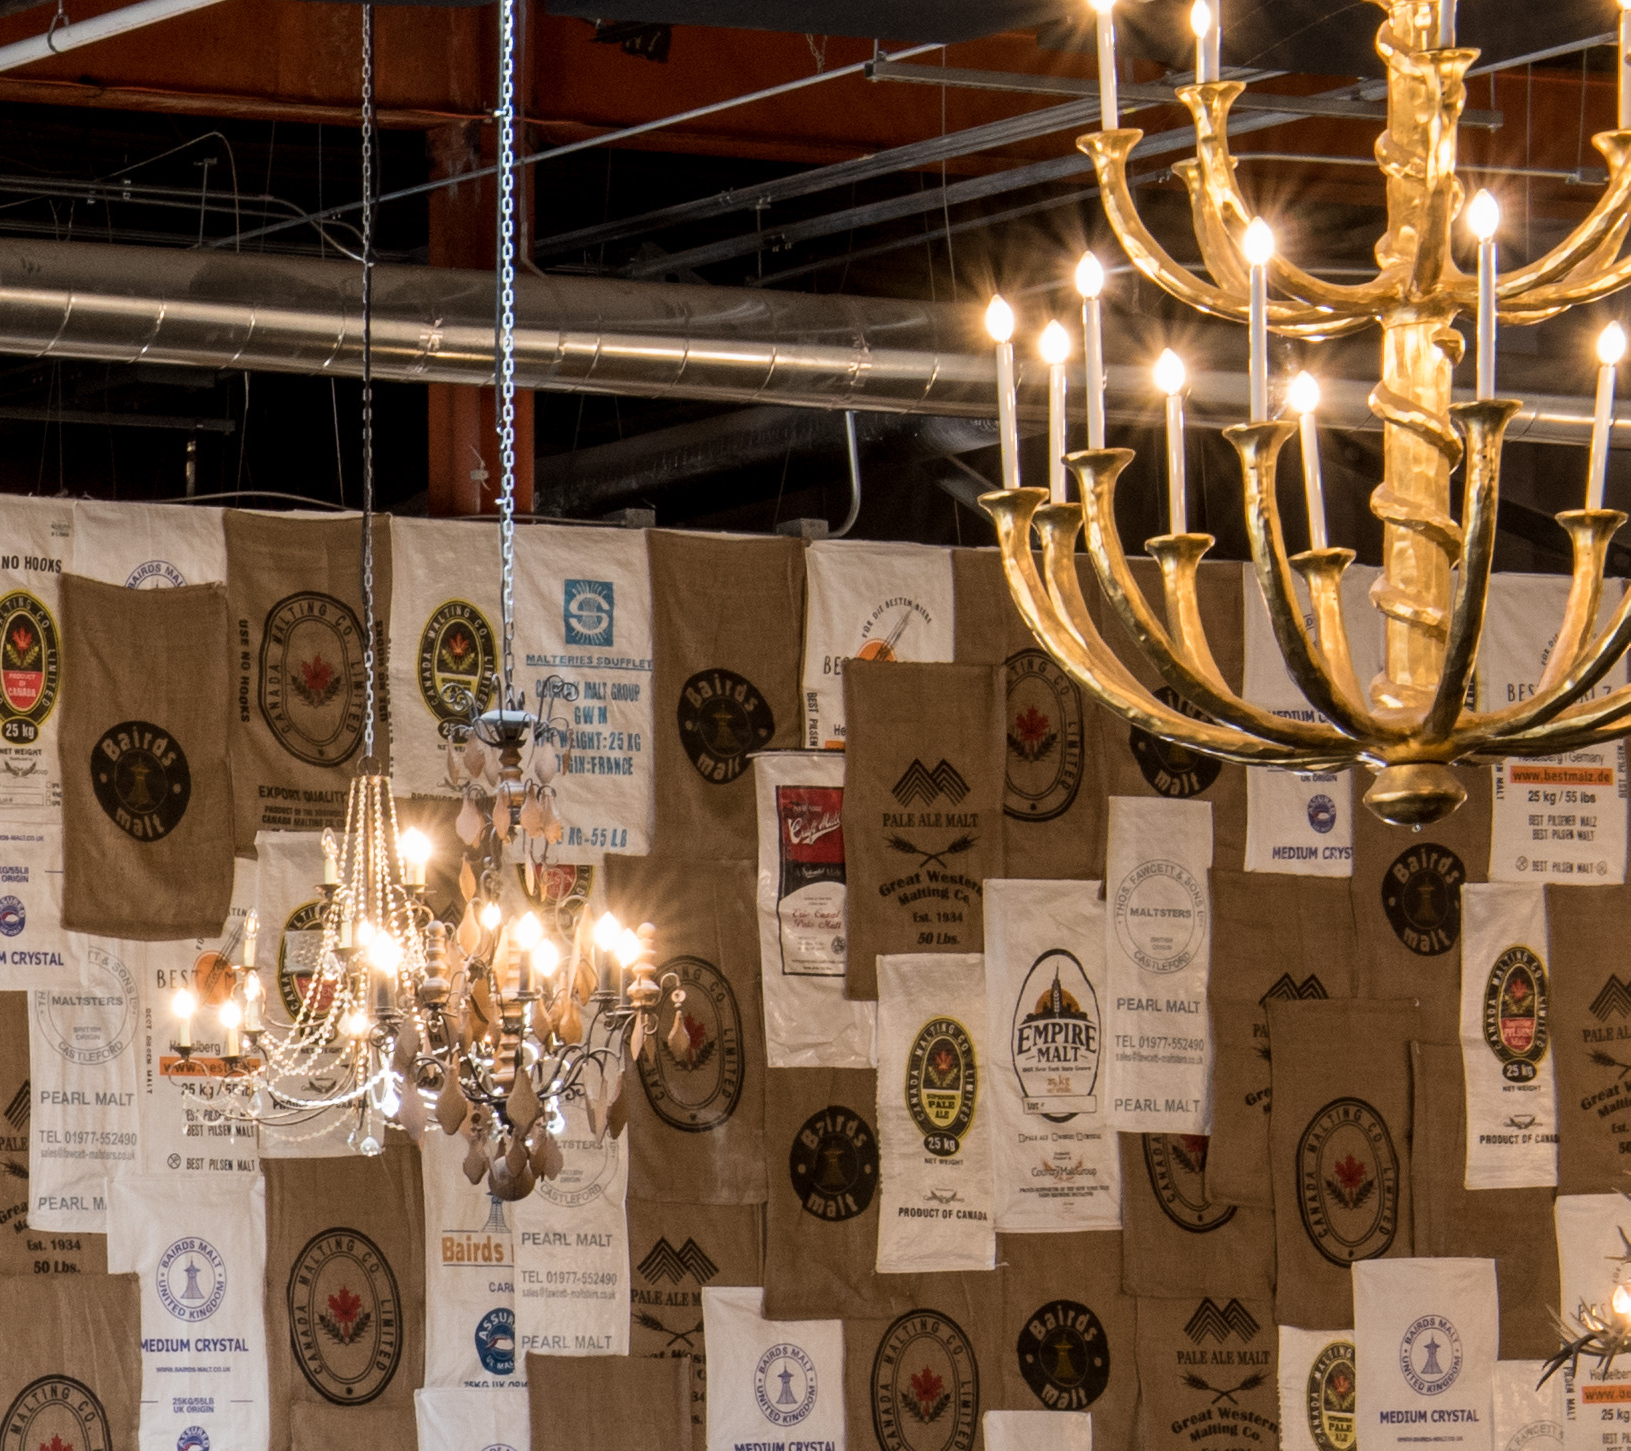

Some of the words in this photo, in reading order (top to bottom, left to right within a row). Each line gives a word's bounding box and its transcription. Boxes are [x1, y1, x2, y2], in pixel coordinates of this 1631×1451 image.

[1, 555, 20, 570] NO
[24, 557, 62, 573] HOOKS
[6, 724, 20, 737] 25
[22, 724, 35, 739] kg
[101, 727, 177, 768] Bairds
[115, 808, 165, 834] malt
[11, 951, 64, 967] CRYSTAL
[1016, 1022, 1097, 1056] EMPIRE
[1037, 1046, 1082, 1063] MALT
[1380, 1410, 1427, 1425] MEDIUM
[1429, 1409, 1479, 1423] CRYSTAL
